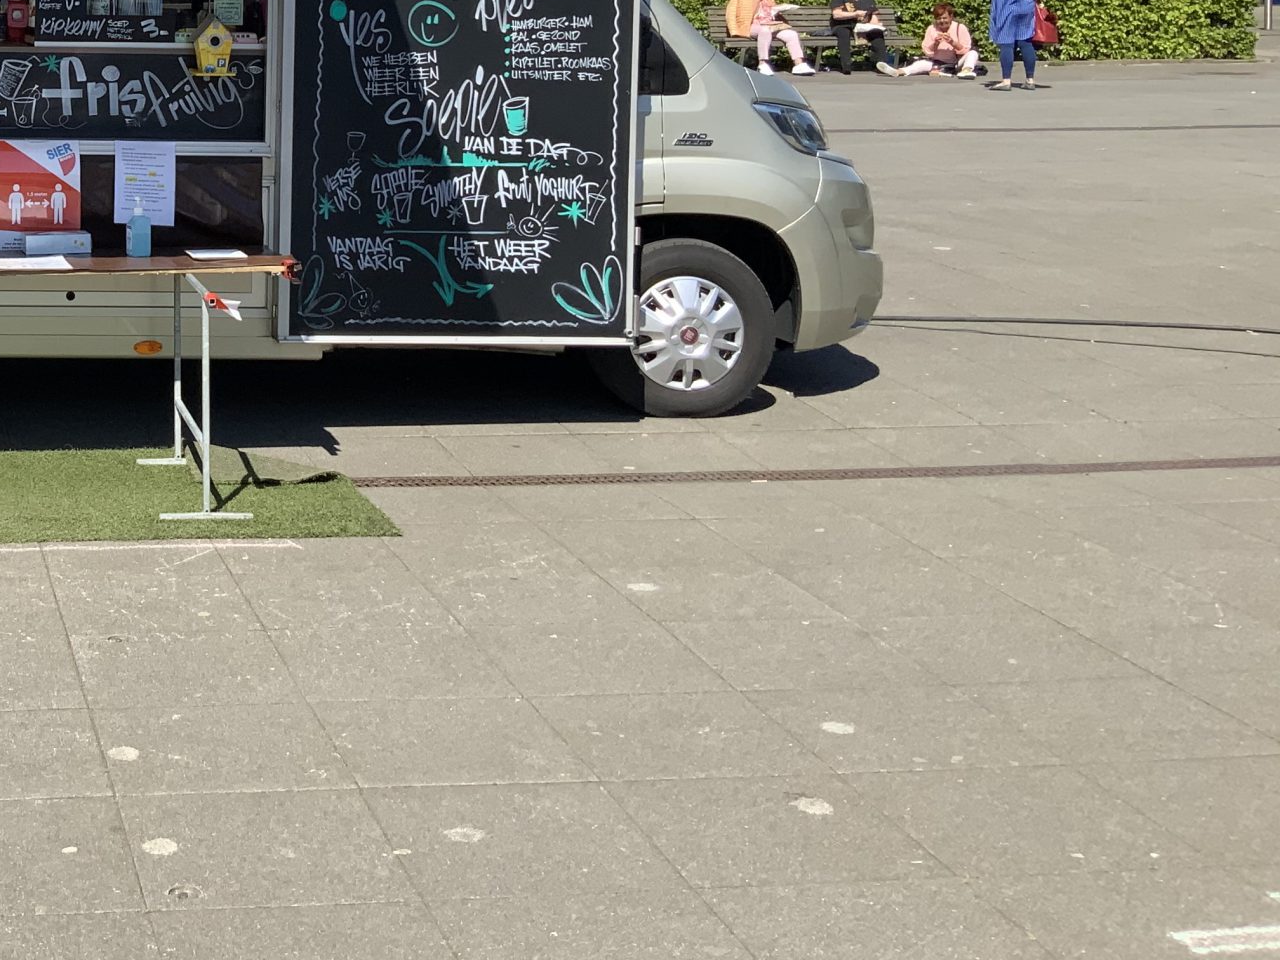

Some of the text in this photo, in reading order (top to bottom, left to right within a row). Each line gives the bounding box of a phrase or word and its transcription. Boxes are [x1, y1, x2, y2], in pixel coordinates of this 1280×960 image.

[510, 15, 594, 31] HAMBURGER HAM
[510, 30, 581, 42] BAL GEZOND
[510, 41, 588, 54] KAAS OMELET
[362, 50, 438, 67] WE HEBBEN
[511, 56, 612, 69] KIPFILET ROOMKAAS
[363, 66, 439, 81] WEER EEN
[42, 56, 147, 117] fris
[46, 143, 73, 160] SIER
[463, 136, 577, 161] VAN DE DAG
[534, 173, 600, 206] YOGHURT
[327, 236, 396, 256] VANDAAG
[448, 236, 552, 259] HET WEER
[335, 254, 412, 272] IS JARIG
[456, 256, 543, 274] VANDAAG
